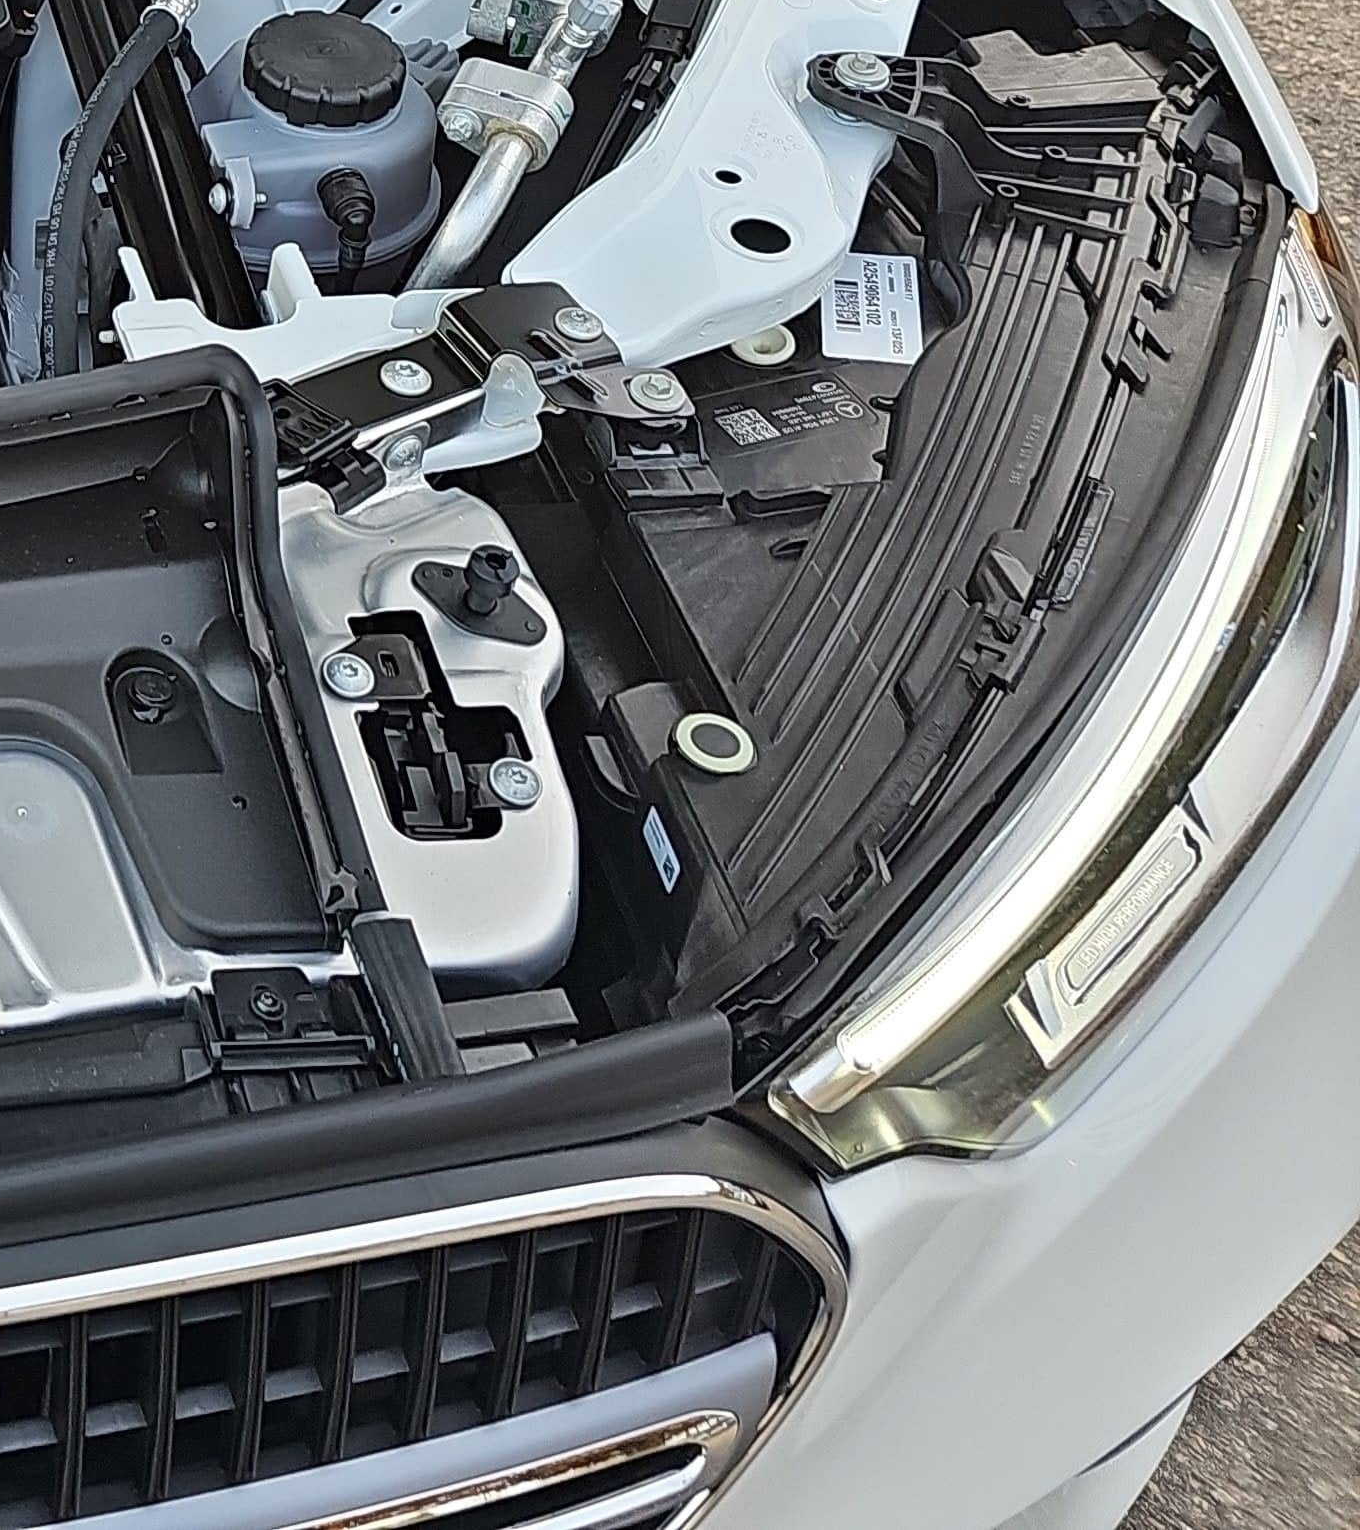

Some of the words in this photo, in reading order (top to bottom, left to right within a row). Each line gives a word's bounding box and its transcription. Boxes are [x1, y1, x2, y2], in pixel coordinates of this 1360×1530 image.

[43, 274, 55, 320] 11:27:01
[863, 259, 882, 327] A2549064102
[1076, 949, 1101, 970] LED
[1092, 922, 1120, 950] HIGH
[1114, 857, 1175, 928] PERFORMANCE
